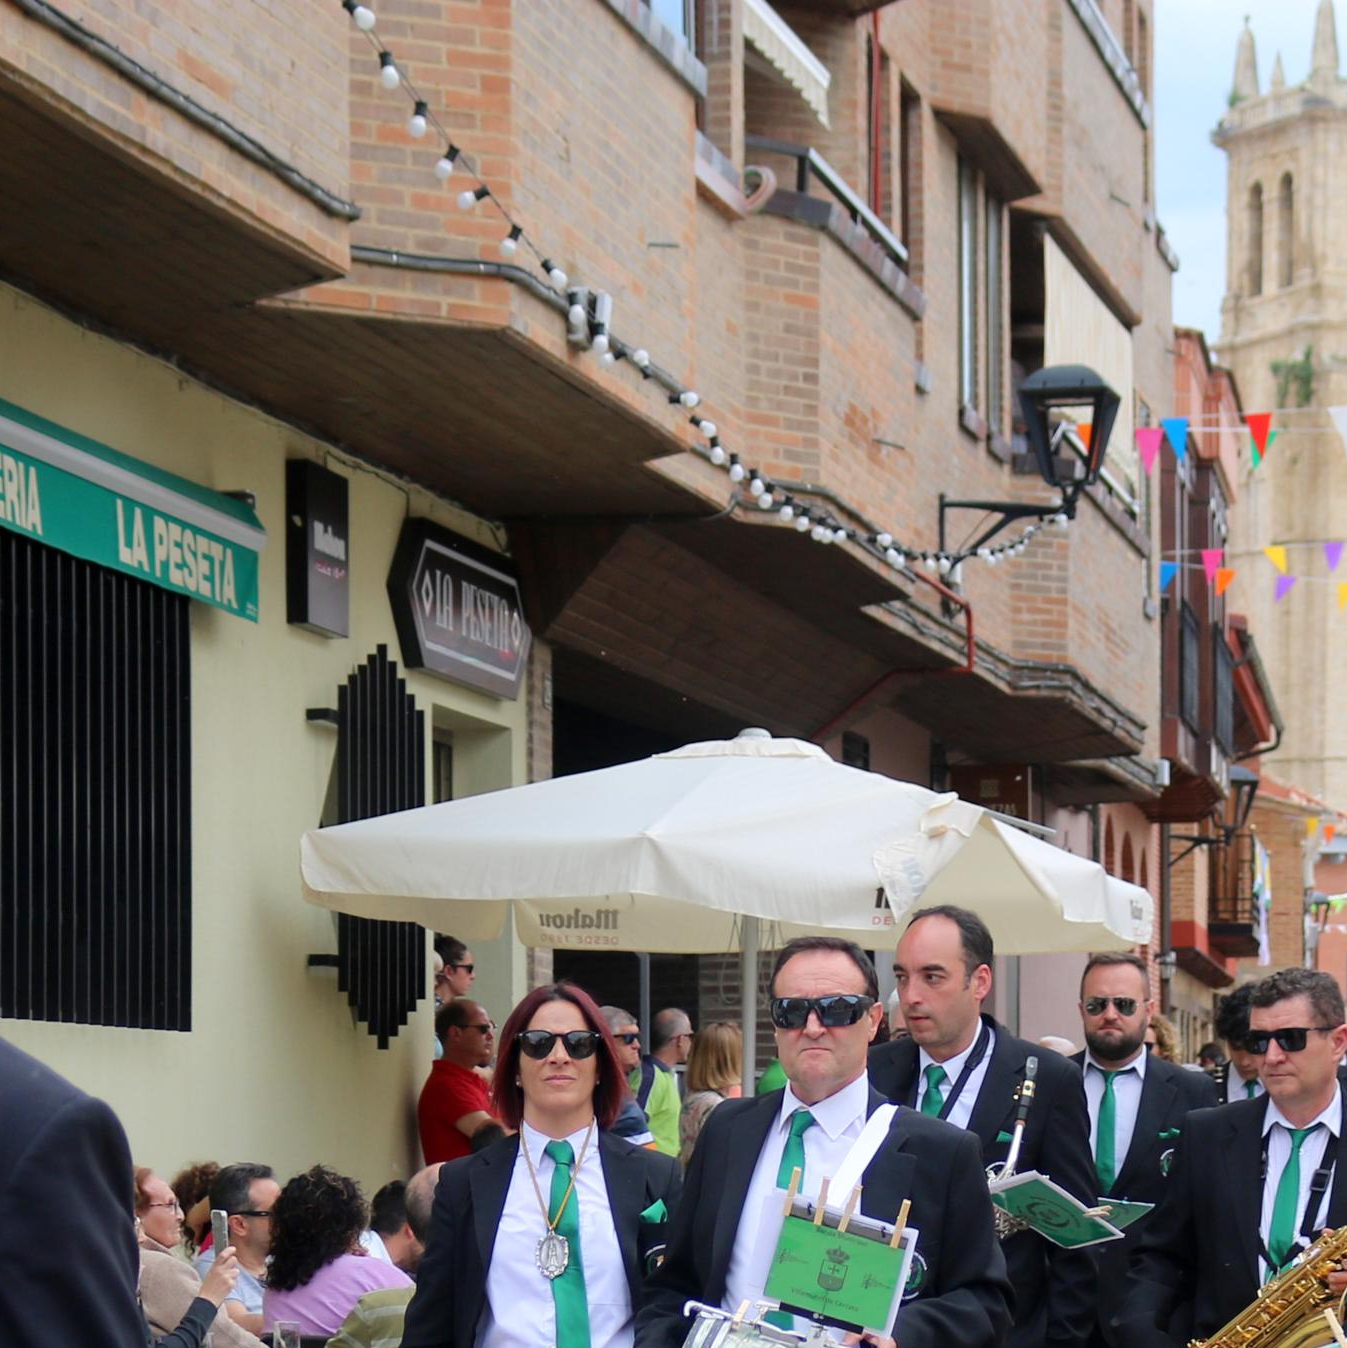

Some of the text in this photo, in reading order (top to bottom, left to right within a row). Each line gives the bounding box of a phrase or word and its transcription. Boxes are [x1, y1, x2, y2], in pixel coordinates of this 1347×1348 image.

[115, 498, 239, 611] LA PESETA
[435, 569, 510, 653] LA PESETA
